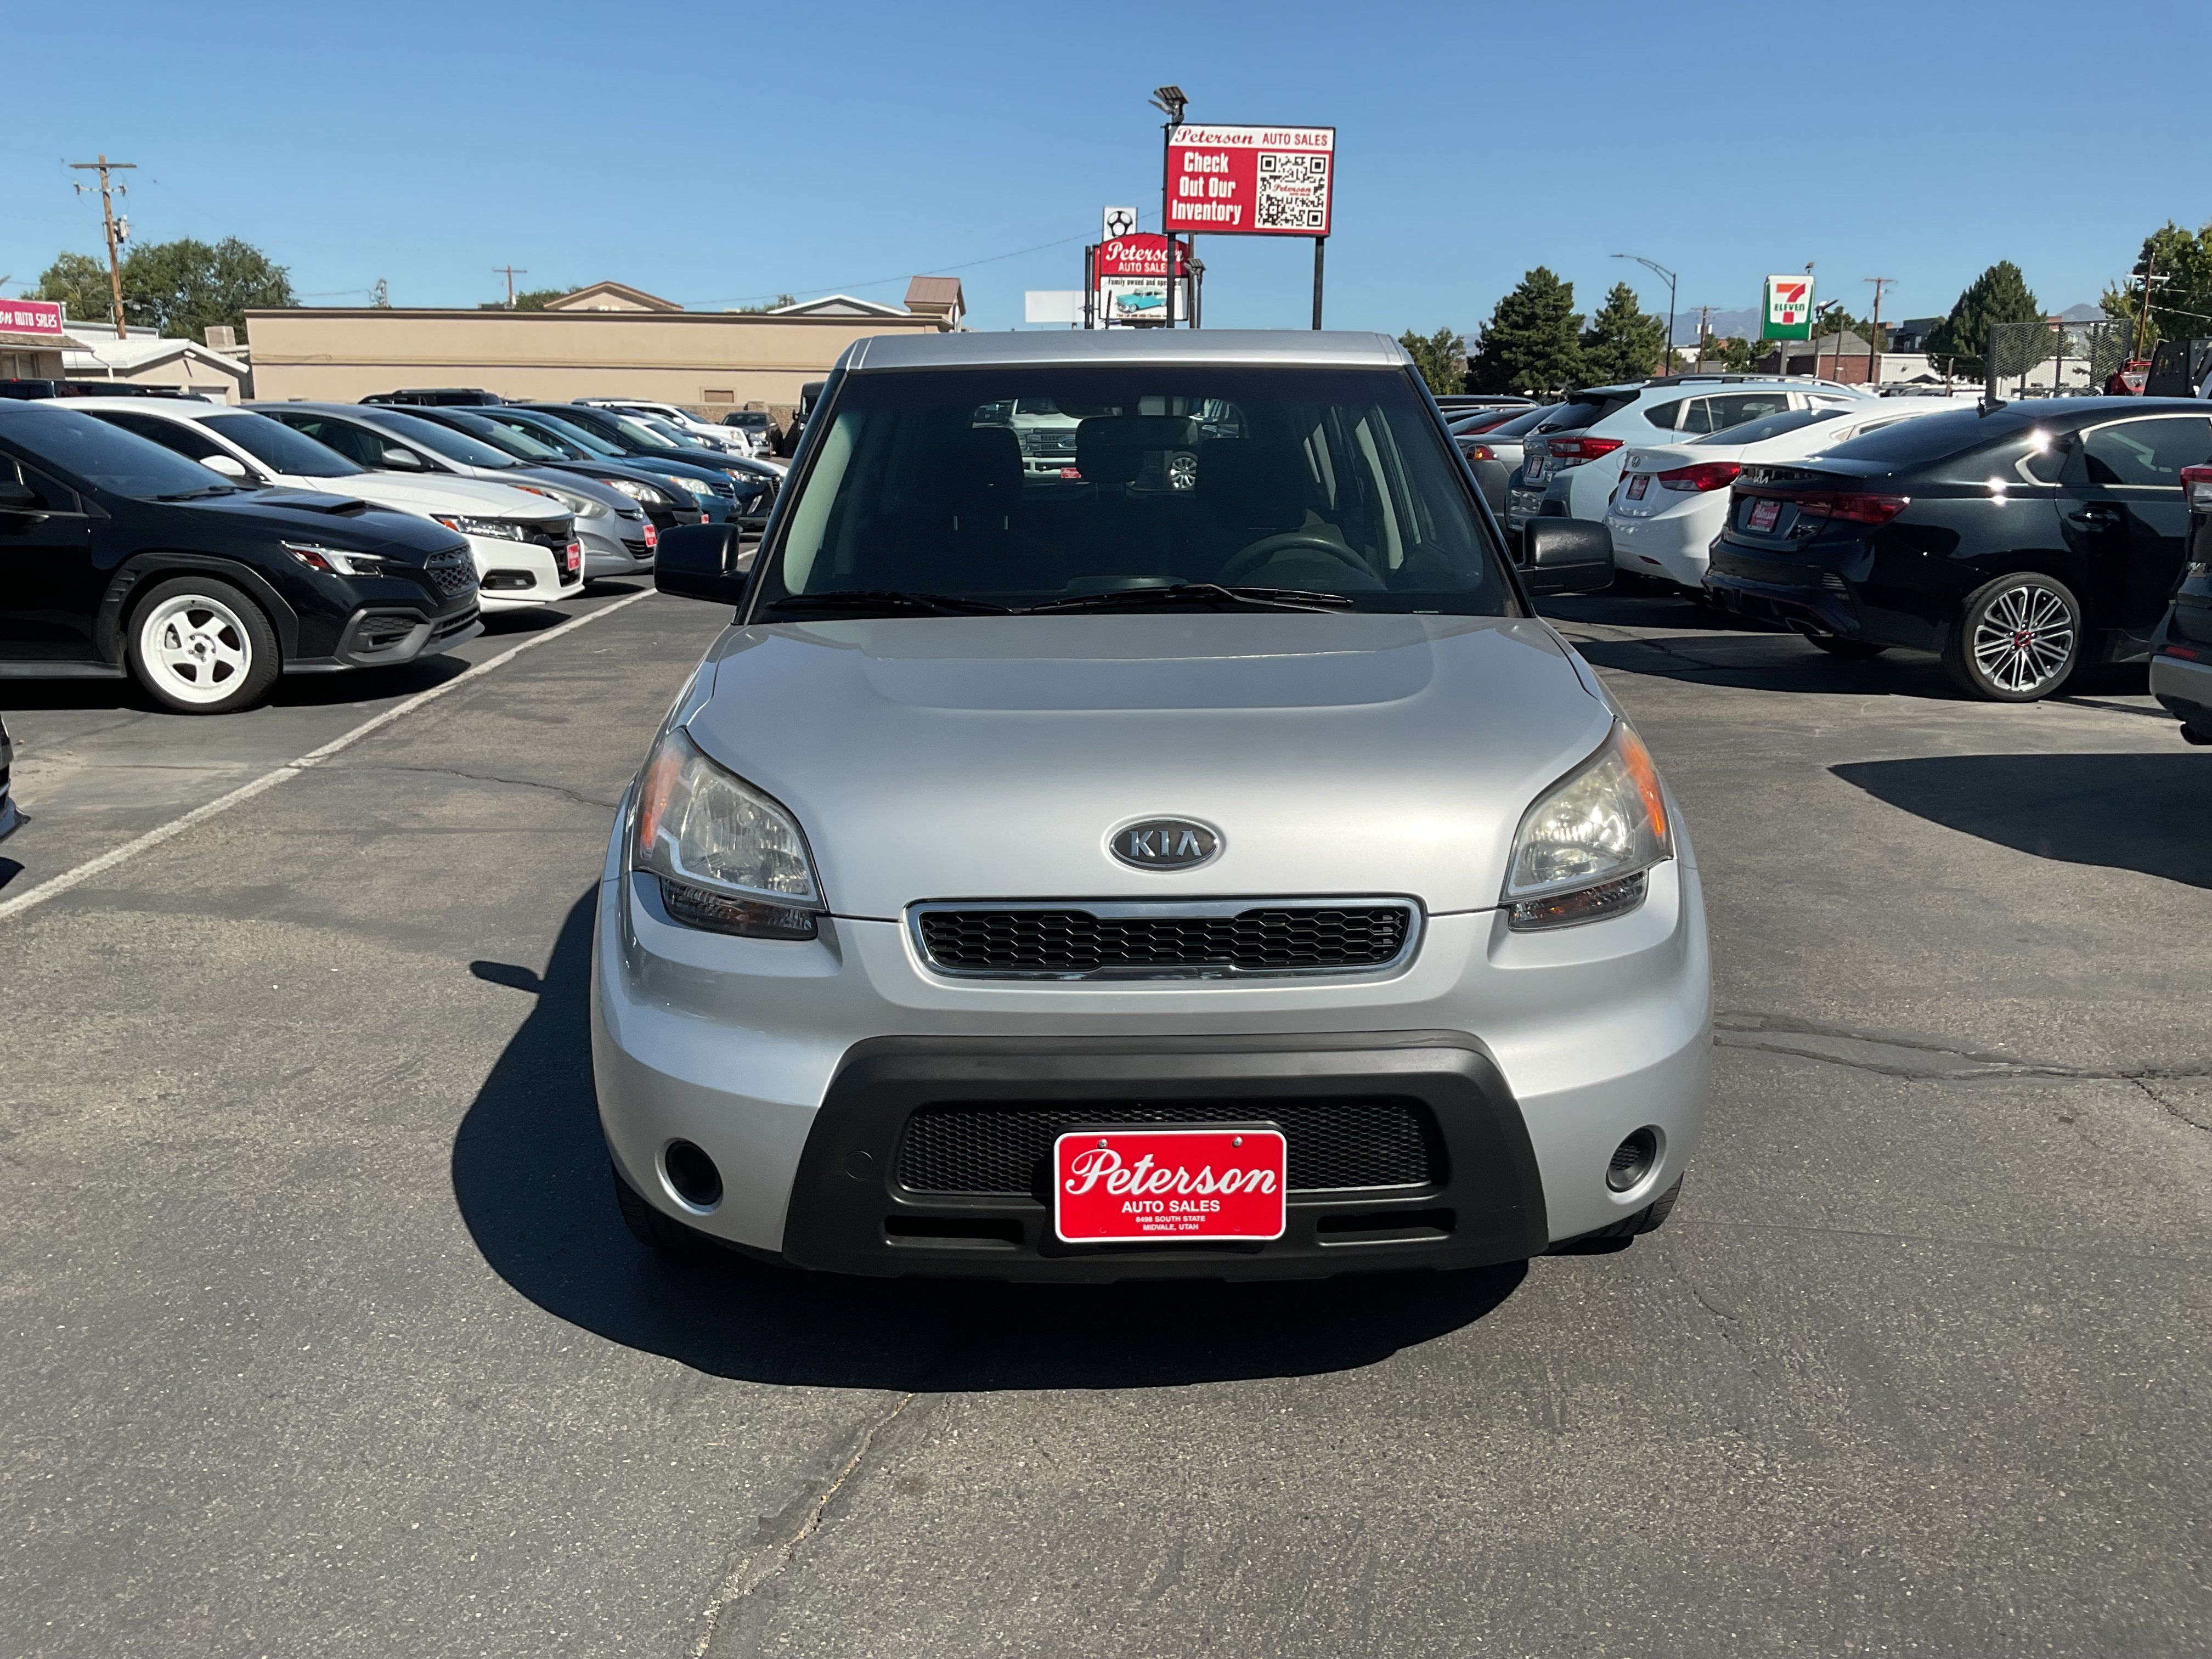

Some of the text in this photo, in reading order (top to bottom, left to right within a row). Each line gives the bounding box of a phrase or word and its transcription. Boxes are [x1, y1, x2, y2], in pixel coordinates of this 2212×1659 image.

[1175, 128, 1328, 146] Peterson AUTO SALES
[1184, 151, 1229, 173] Check
[1180, 176, 1235, 198] Out Our
[1172, 199, 1242, 225] Inventory
[1118, 262, 1168, 273] AUTO SALE
[1109, 278, 1125, 286] Family
[14, 311, 34, 326] AUTO
[36, 313, 57, 328] SALES
[1128, 830, 1202, 856] KIA
[1065, 1148, 1277, 1195] Peterson
[1121, 1200, 1220, 1213] AUTO SALES
